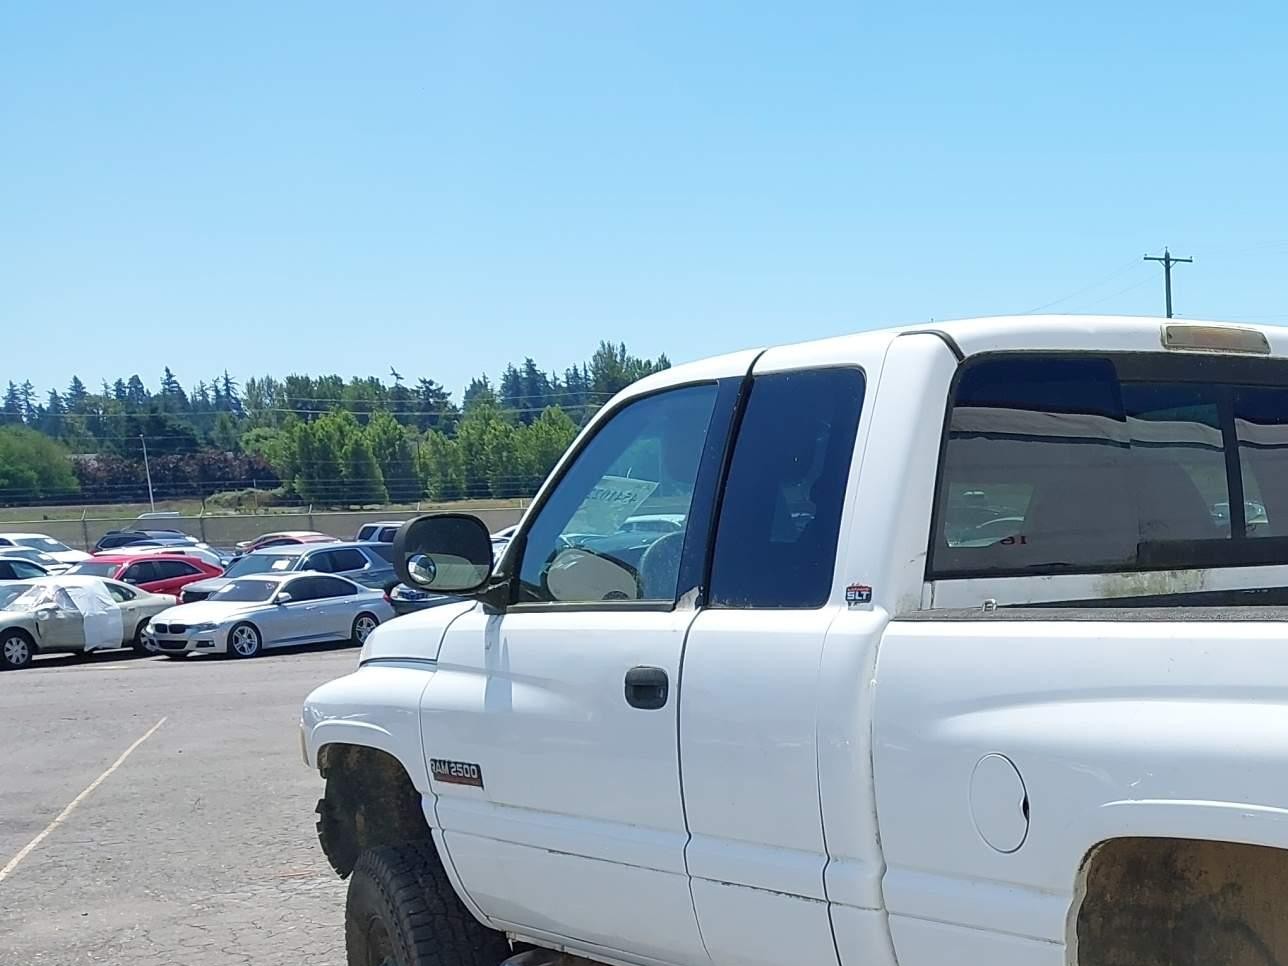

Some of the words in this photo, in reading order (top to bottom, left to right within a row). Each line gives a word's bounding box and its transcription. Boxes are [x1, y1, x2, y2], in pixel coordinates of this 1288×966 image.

[847, 591, 870, 600] SLT
[430, 760, 449, 775] RAM
[451, 764, 478, 779] 2500
